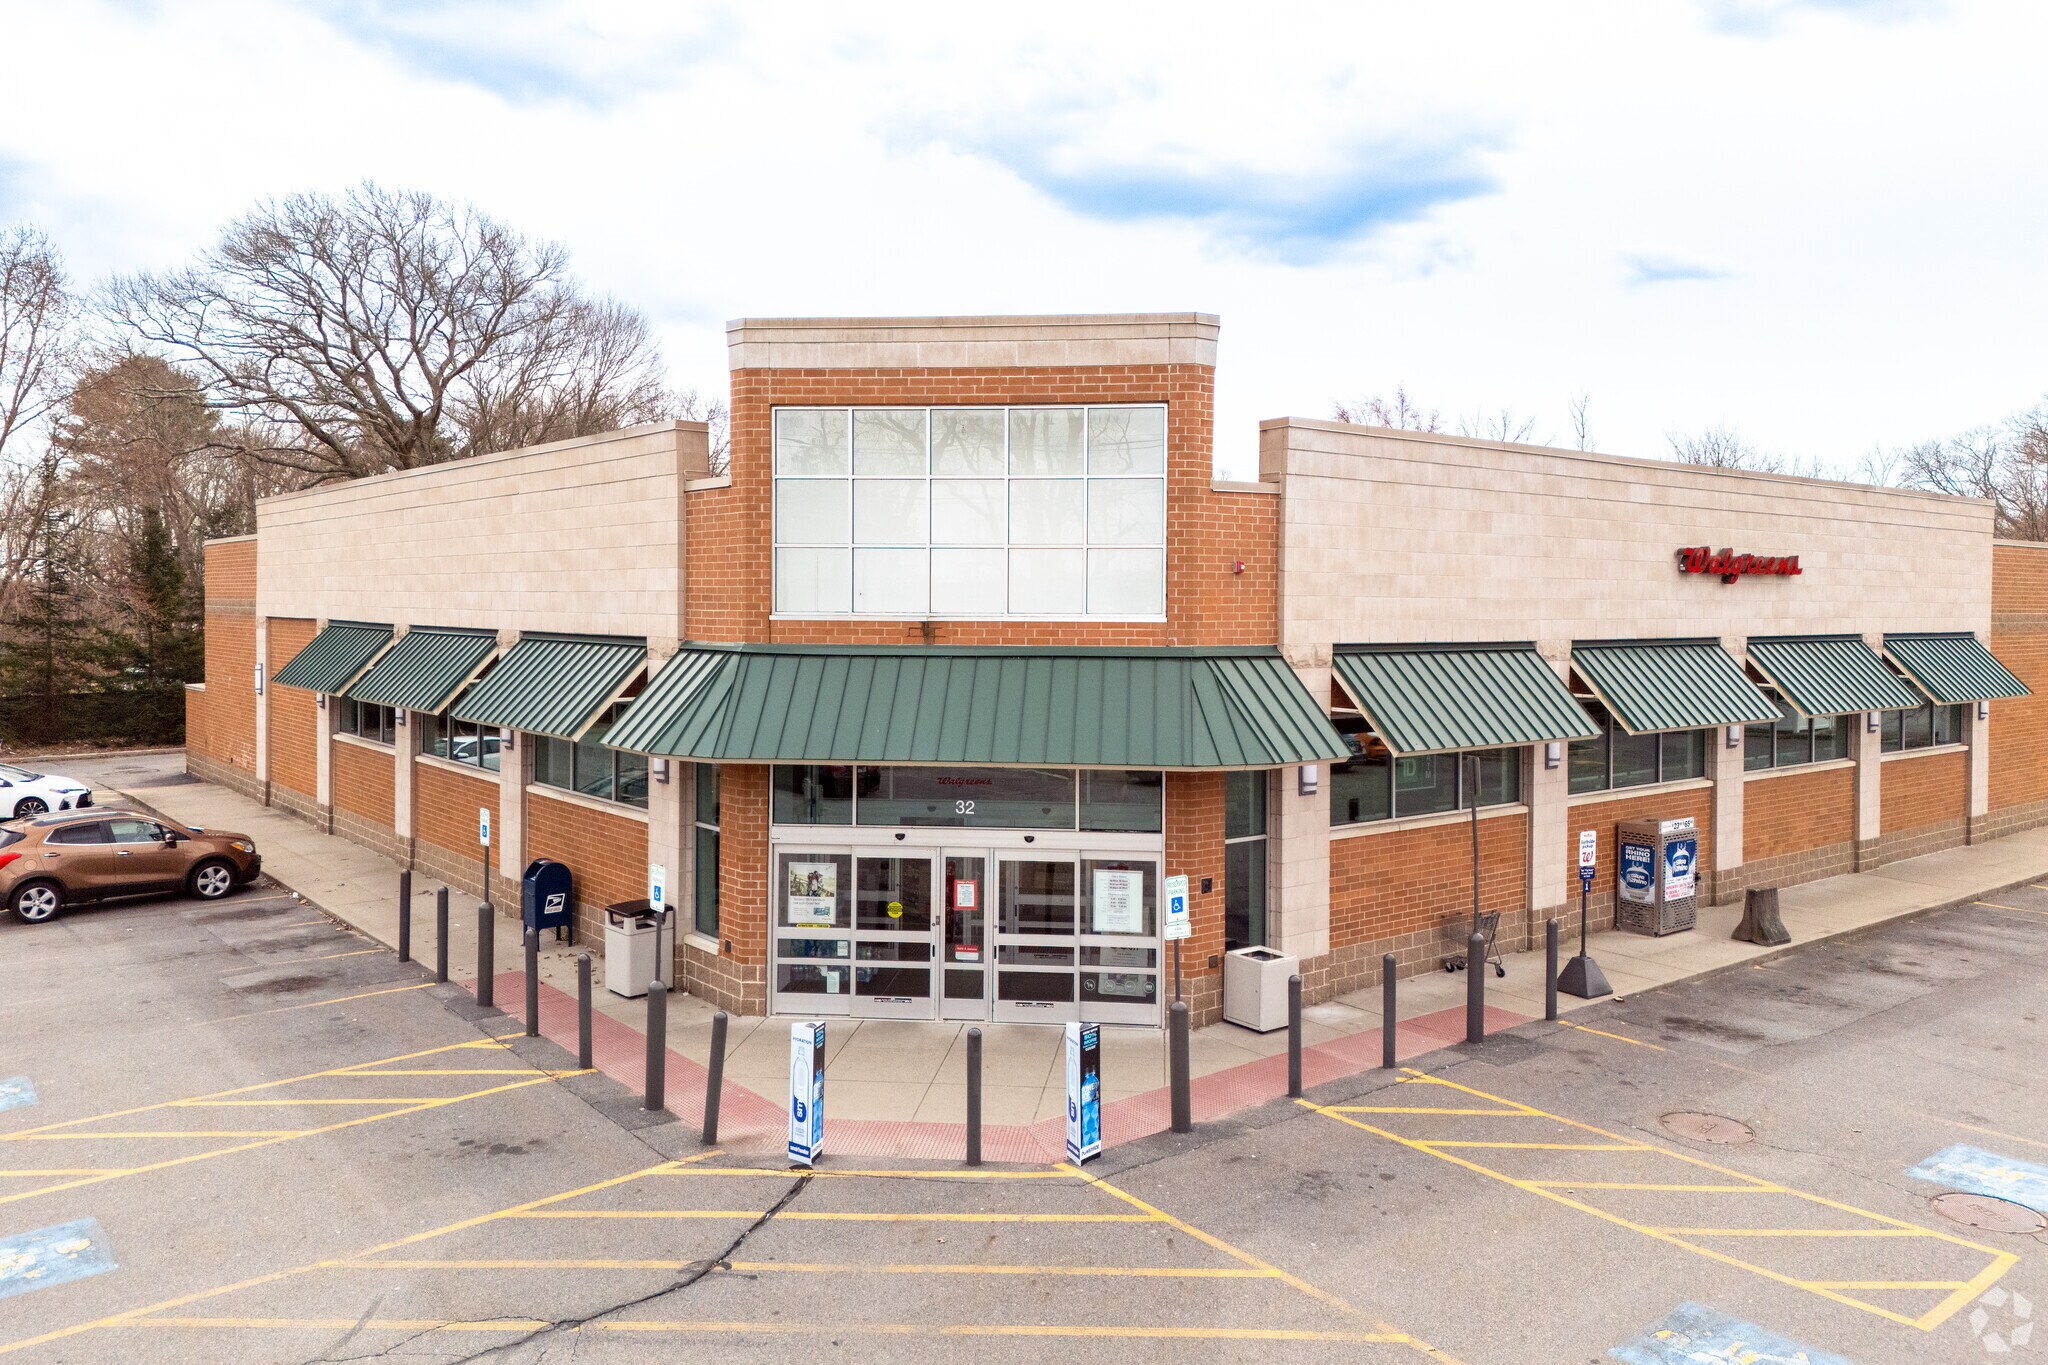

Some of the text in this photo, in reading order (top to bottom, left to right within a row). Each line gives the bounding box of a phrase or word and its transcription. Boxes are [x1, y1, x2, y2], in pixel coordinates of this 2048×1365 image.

[1674, 546, 1803, 585] Walgreens
[937, 776, 992, 788] Walgreens
[955, 800, 975, 815] 32
[1625, 849, 1650, 857] RHINO
[1167, 880, 1186, 889] RESERVED
[1167, 887, 1185, 896] PARKING
[792, 1037, 812, 1045] HYDRATION
